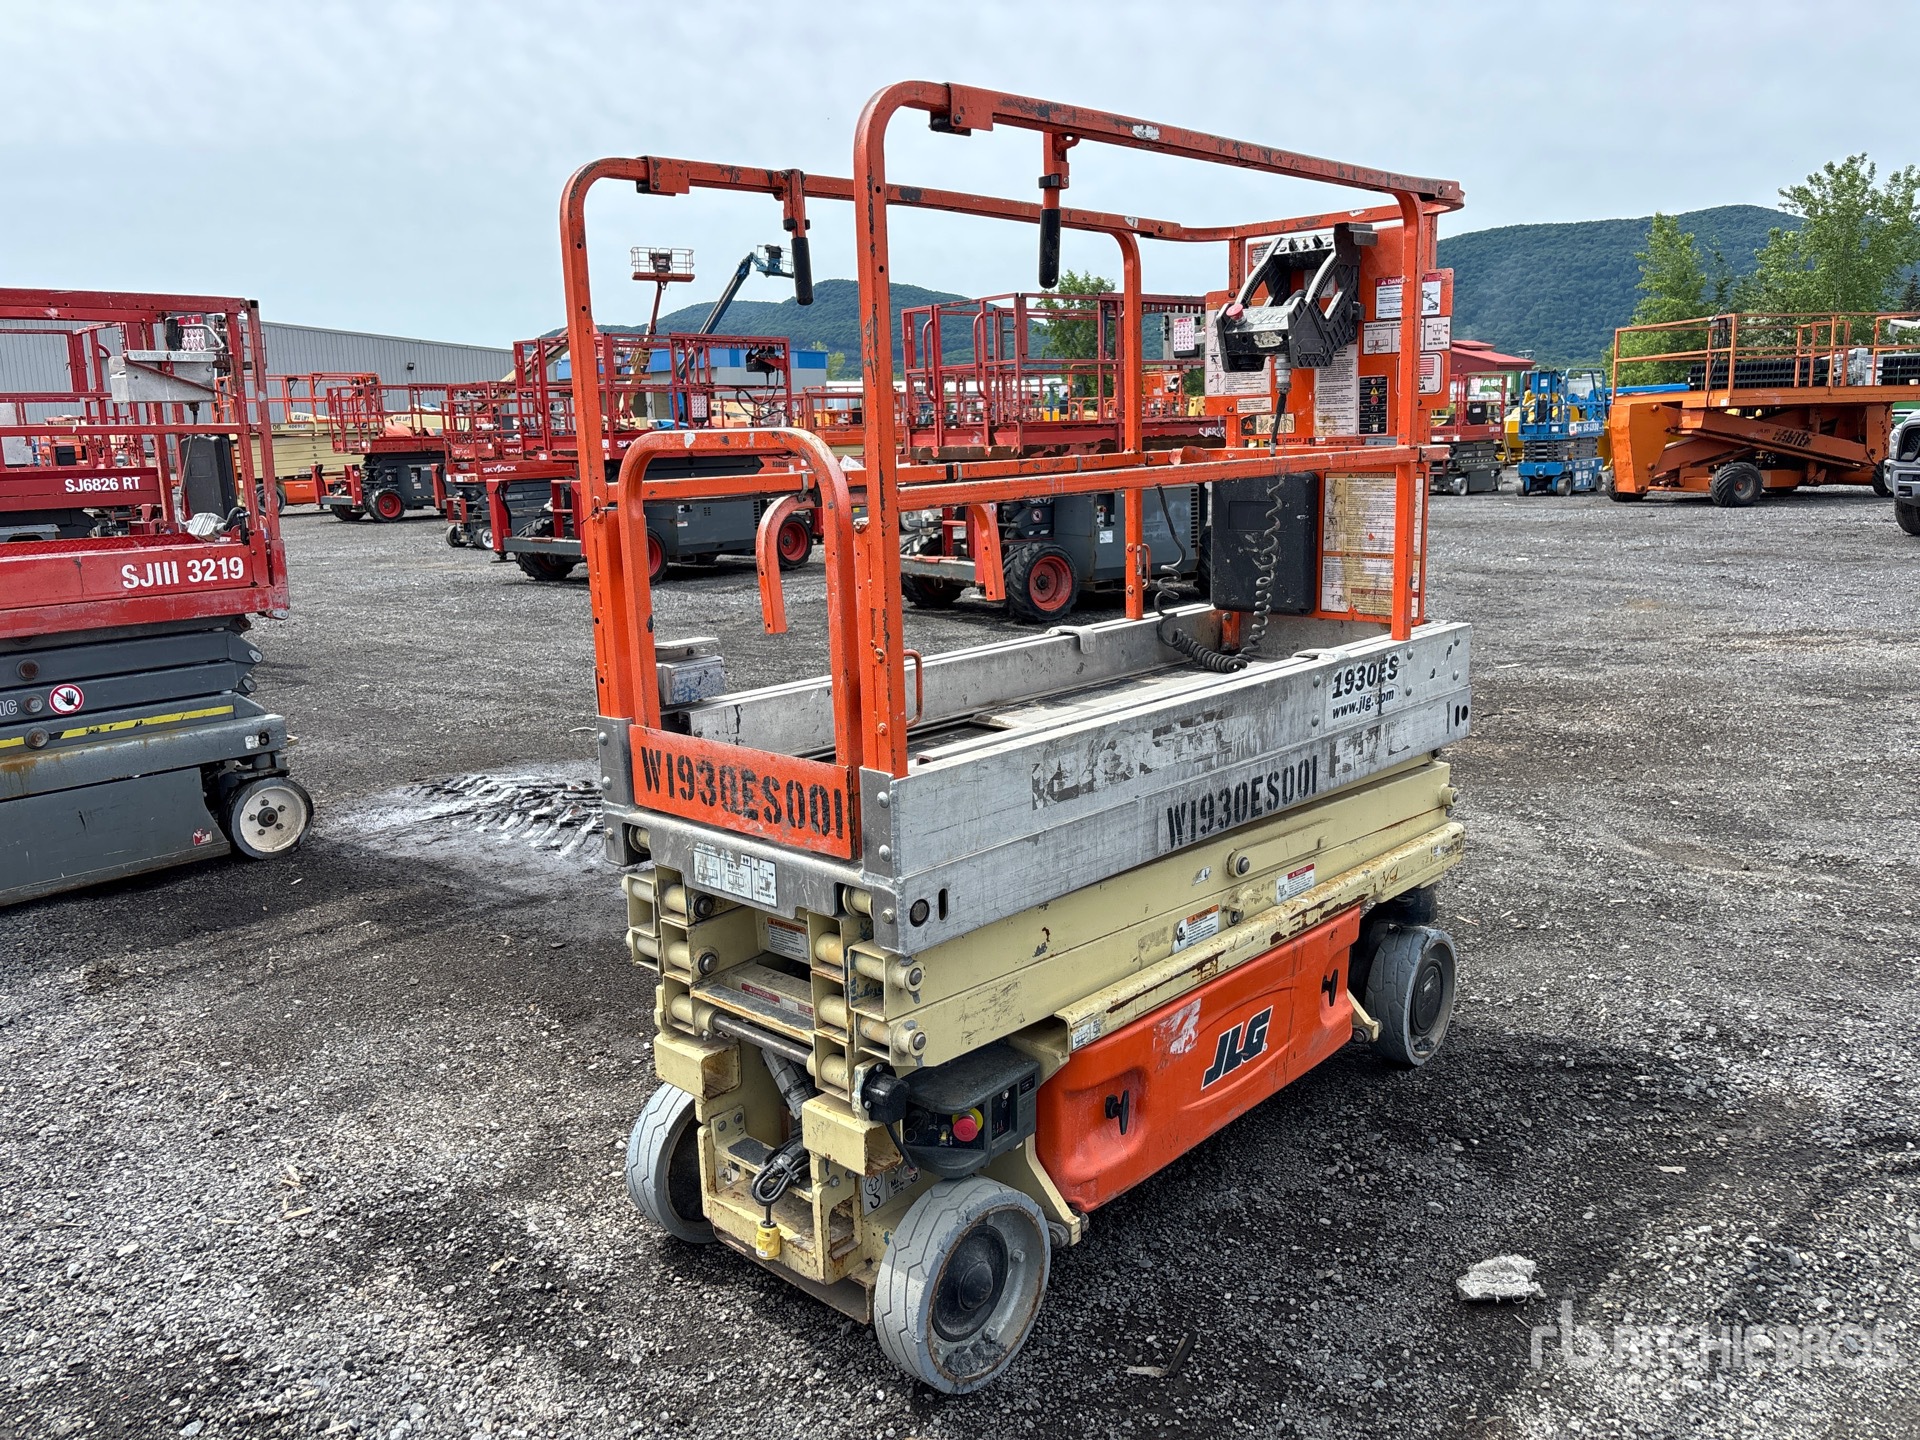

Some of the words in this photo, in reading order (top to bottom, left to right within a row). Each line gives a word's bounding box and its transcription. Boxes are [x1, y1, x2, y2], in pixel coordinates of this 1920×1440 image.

[64, 477, 119, 493] SJ6826
[122, 476, 141, 490] RT
[482, 464, 517, 473] SKYJACK
[121, 561, 179, 589] SJIII
[186, 556, 244, 583] 3219
[1331, 655, 1400, 699] 1930ES
[1201, 1005, 1274, 1090] JLG
